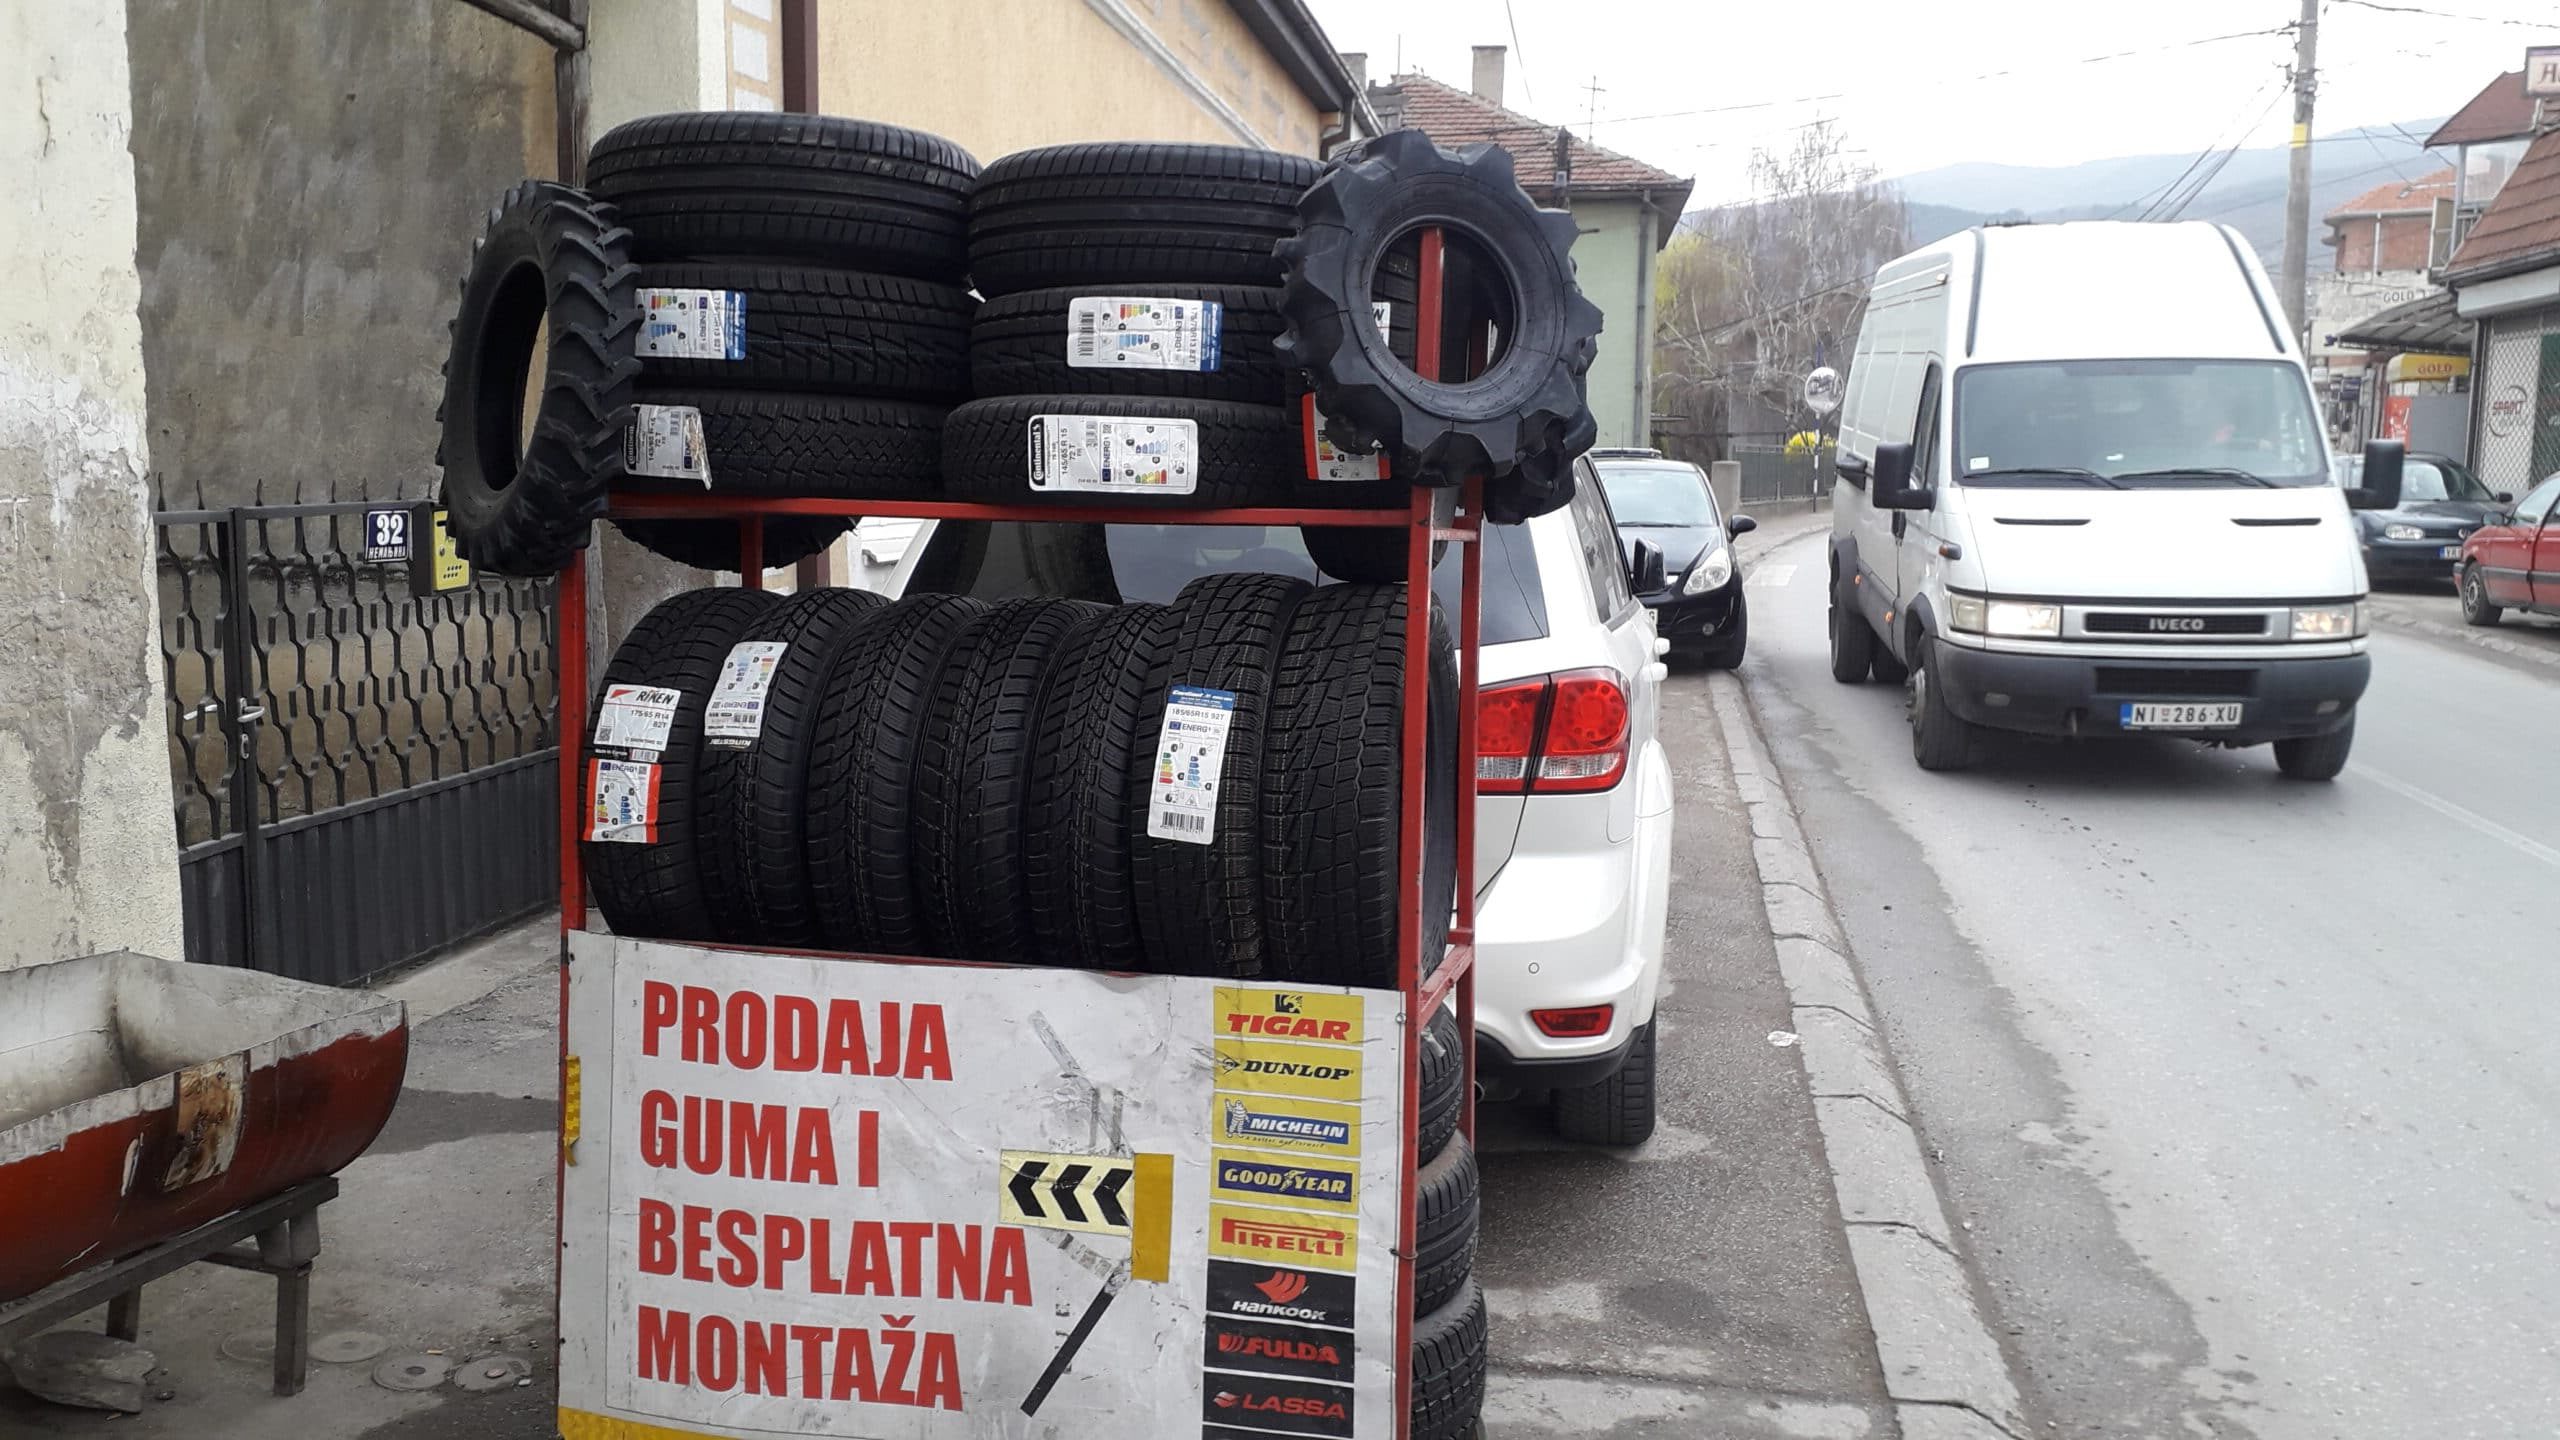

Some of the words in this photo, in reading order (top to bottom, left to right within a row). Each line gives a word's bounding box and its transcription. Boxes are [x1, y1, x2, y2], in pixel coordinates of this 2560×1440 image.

[2417, 362, 2453, 375] GOLD
[1033, 431, 1044, 481] Continental
[377, 514, 404, 545] 32
[2149, 618, 2205, 631] IVECO
[636, 690, 675, 705] RIKEN
[2135, 707, 2155, 722] NI
[642, 980, 954, 1082] PRODAJA
[1227, 1013, 1350, 1040] TIGAR
[1243, 1060, 1351, 1080] DUNLOP
[640, 1089, 839, 1187] GUMA
[858, 1110, 880, 1188] I
[1250, 1118, 1345, 1138] MICHELIN
[1221, 1218, 1345, 1257] PIRELLI
[639, 1198, 1033, 1307] BESPLATNA
[638, 1305, 963, 1412] MONTAŽA
[1244, 1335, 1340, 1365] FULDA
[1243, 1394, 1345, 1419] LASSA
